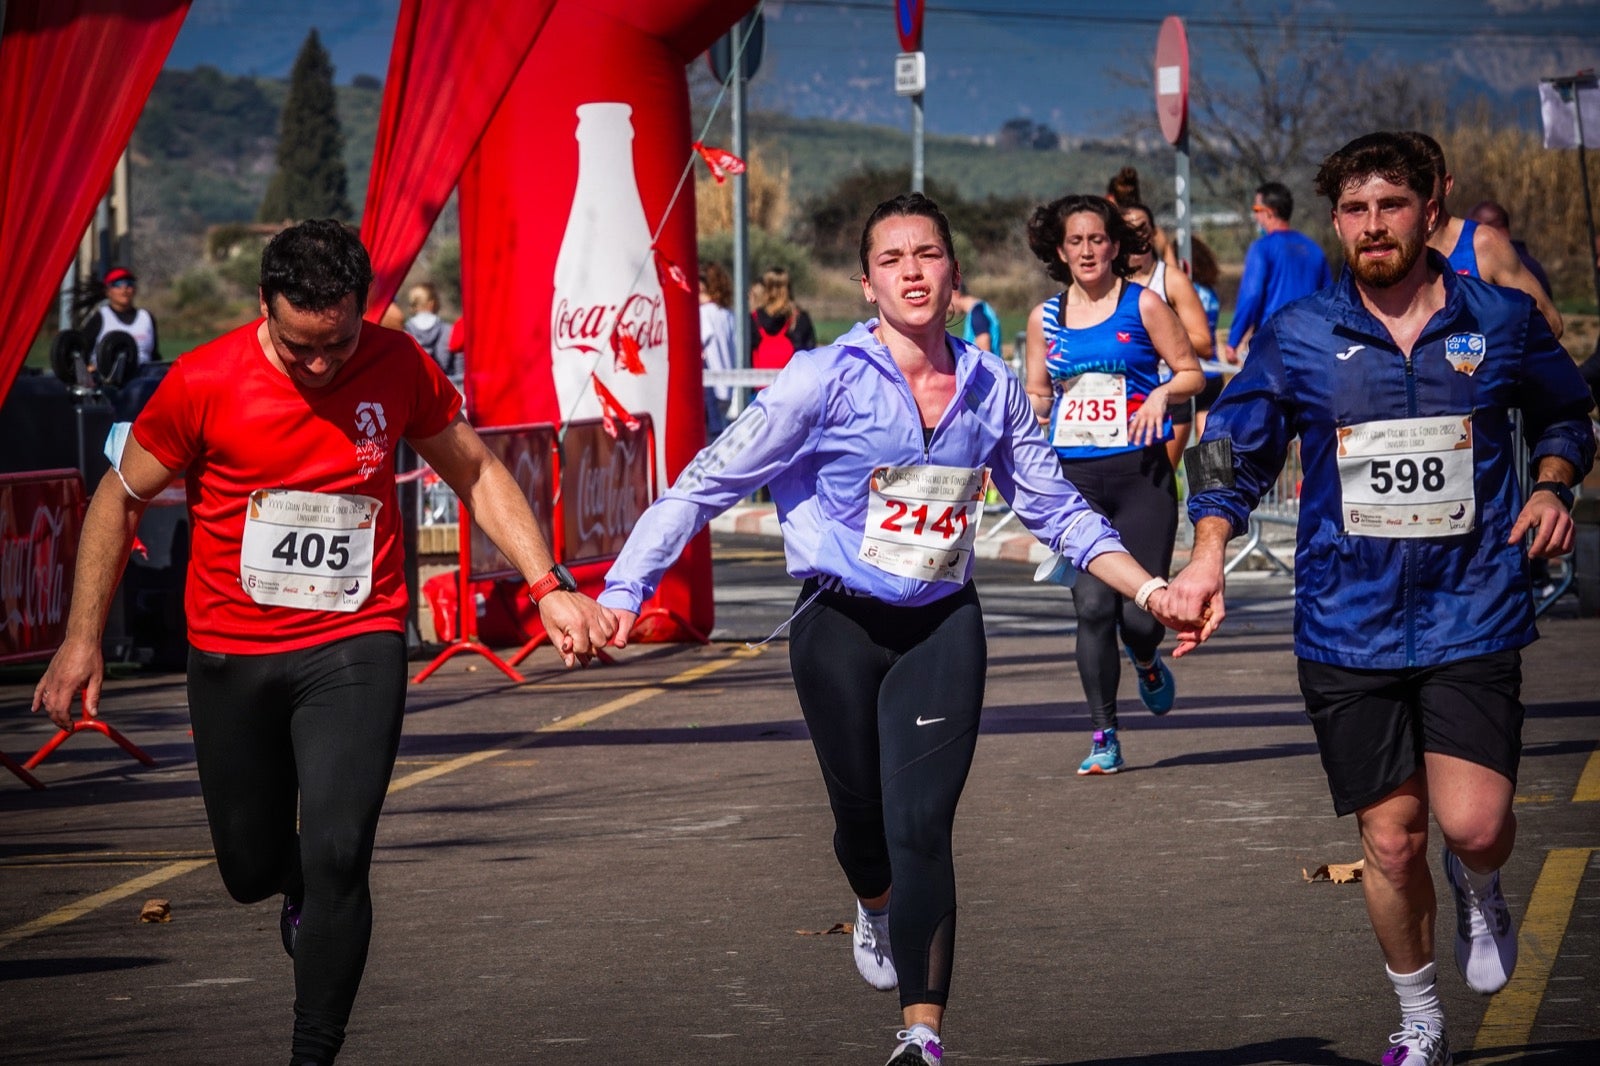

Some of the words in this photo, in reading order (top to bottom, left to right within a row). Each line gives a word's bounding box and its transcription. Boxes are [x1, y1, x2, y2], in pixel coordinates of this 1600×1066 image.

[1064, 399, 1117, 422] 2135
[1370, 457, 1446, 494] 598
[880, 499, 968, 540] 2141
[272, 531, 350, 571] 405
